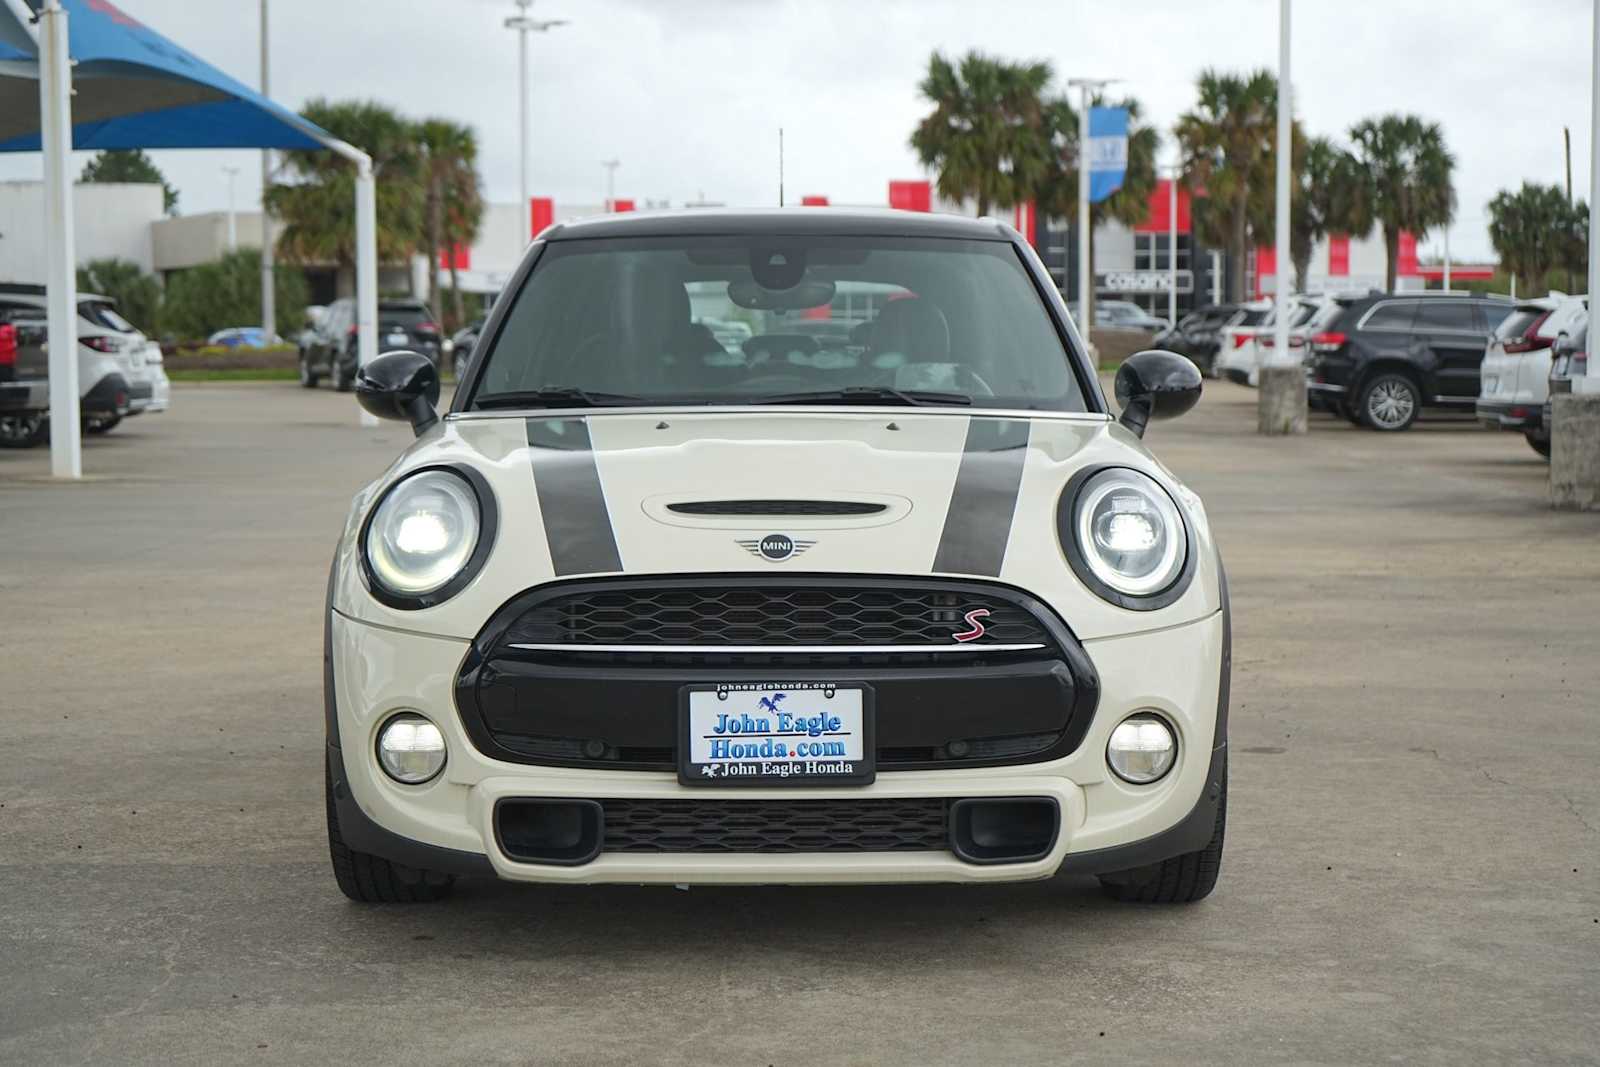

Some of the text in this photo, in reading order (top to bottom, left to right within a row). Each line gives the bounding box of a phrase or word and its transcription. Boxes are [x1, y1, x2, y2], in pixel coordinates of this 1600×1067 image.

[762, 542, 791, 550] MINI
[952, 609, 991, 642] S
[717, 683, 836, 691] johneaglehonda.com
[713, 712, 841, 736] John Eagle
[709, 739, 846, 759] Honda.com
[721, 761, 853, 777] John Eagle Honda
